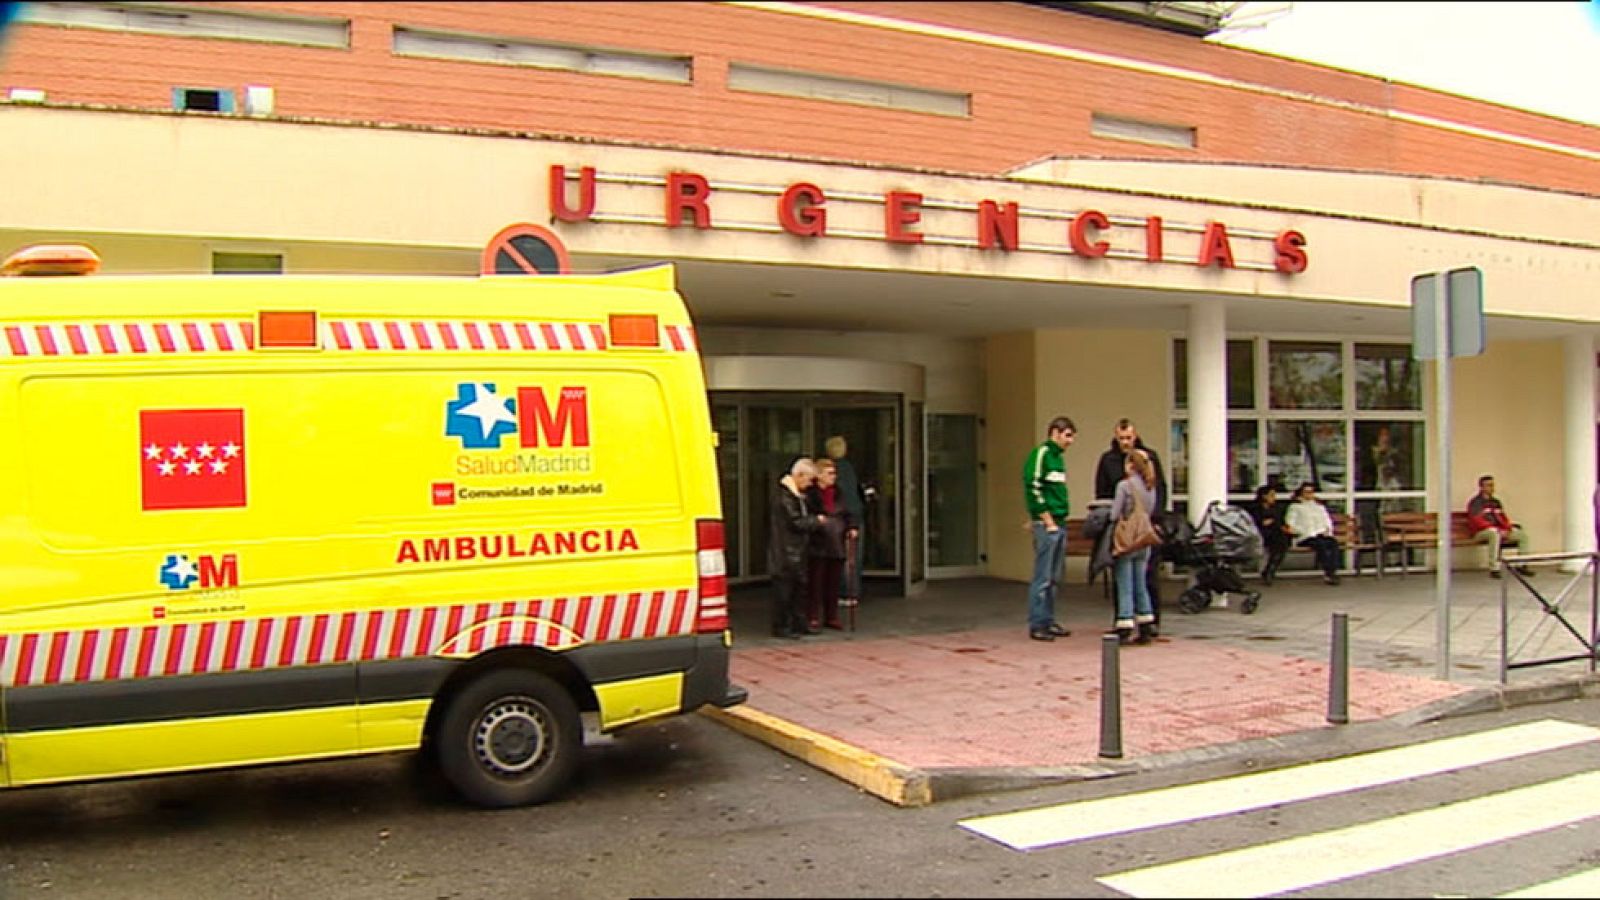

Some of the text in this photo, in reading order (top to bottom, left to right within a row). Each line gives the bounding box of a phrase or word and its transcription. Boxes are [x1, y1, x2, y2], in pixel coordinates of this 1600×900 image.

[549, 165, 1309, 275] URGENCIAS
[458, 483, 603, 500] Comunidad de Madrid
[396, 528, 640, 564] AMBULANCIA
